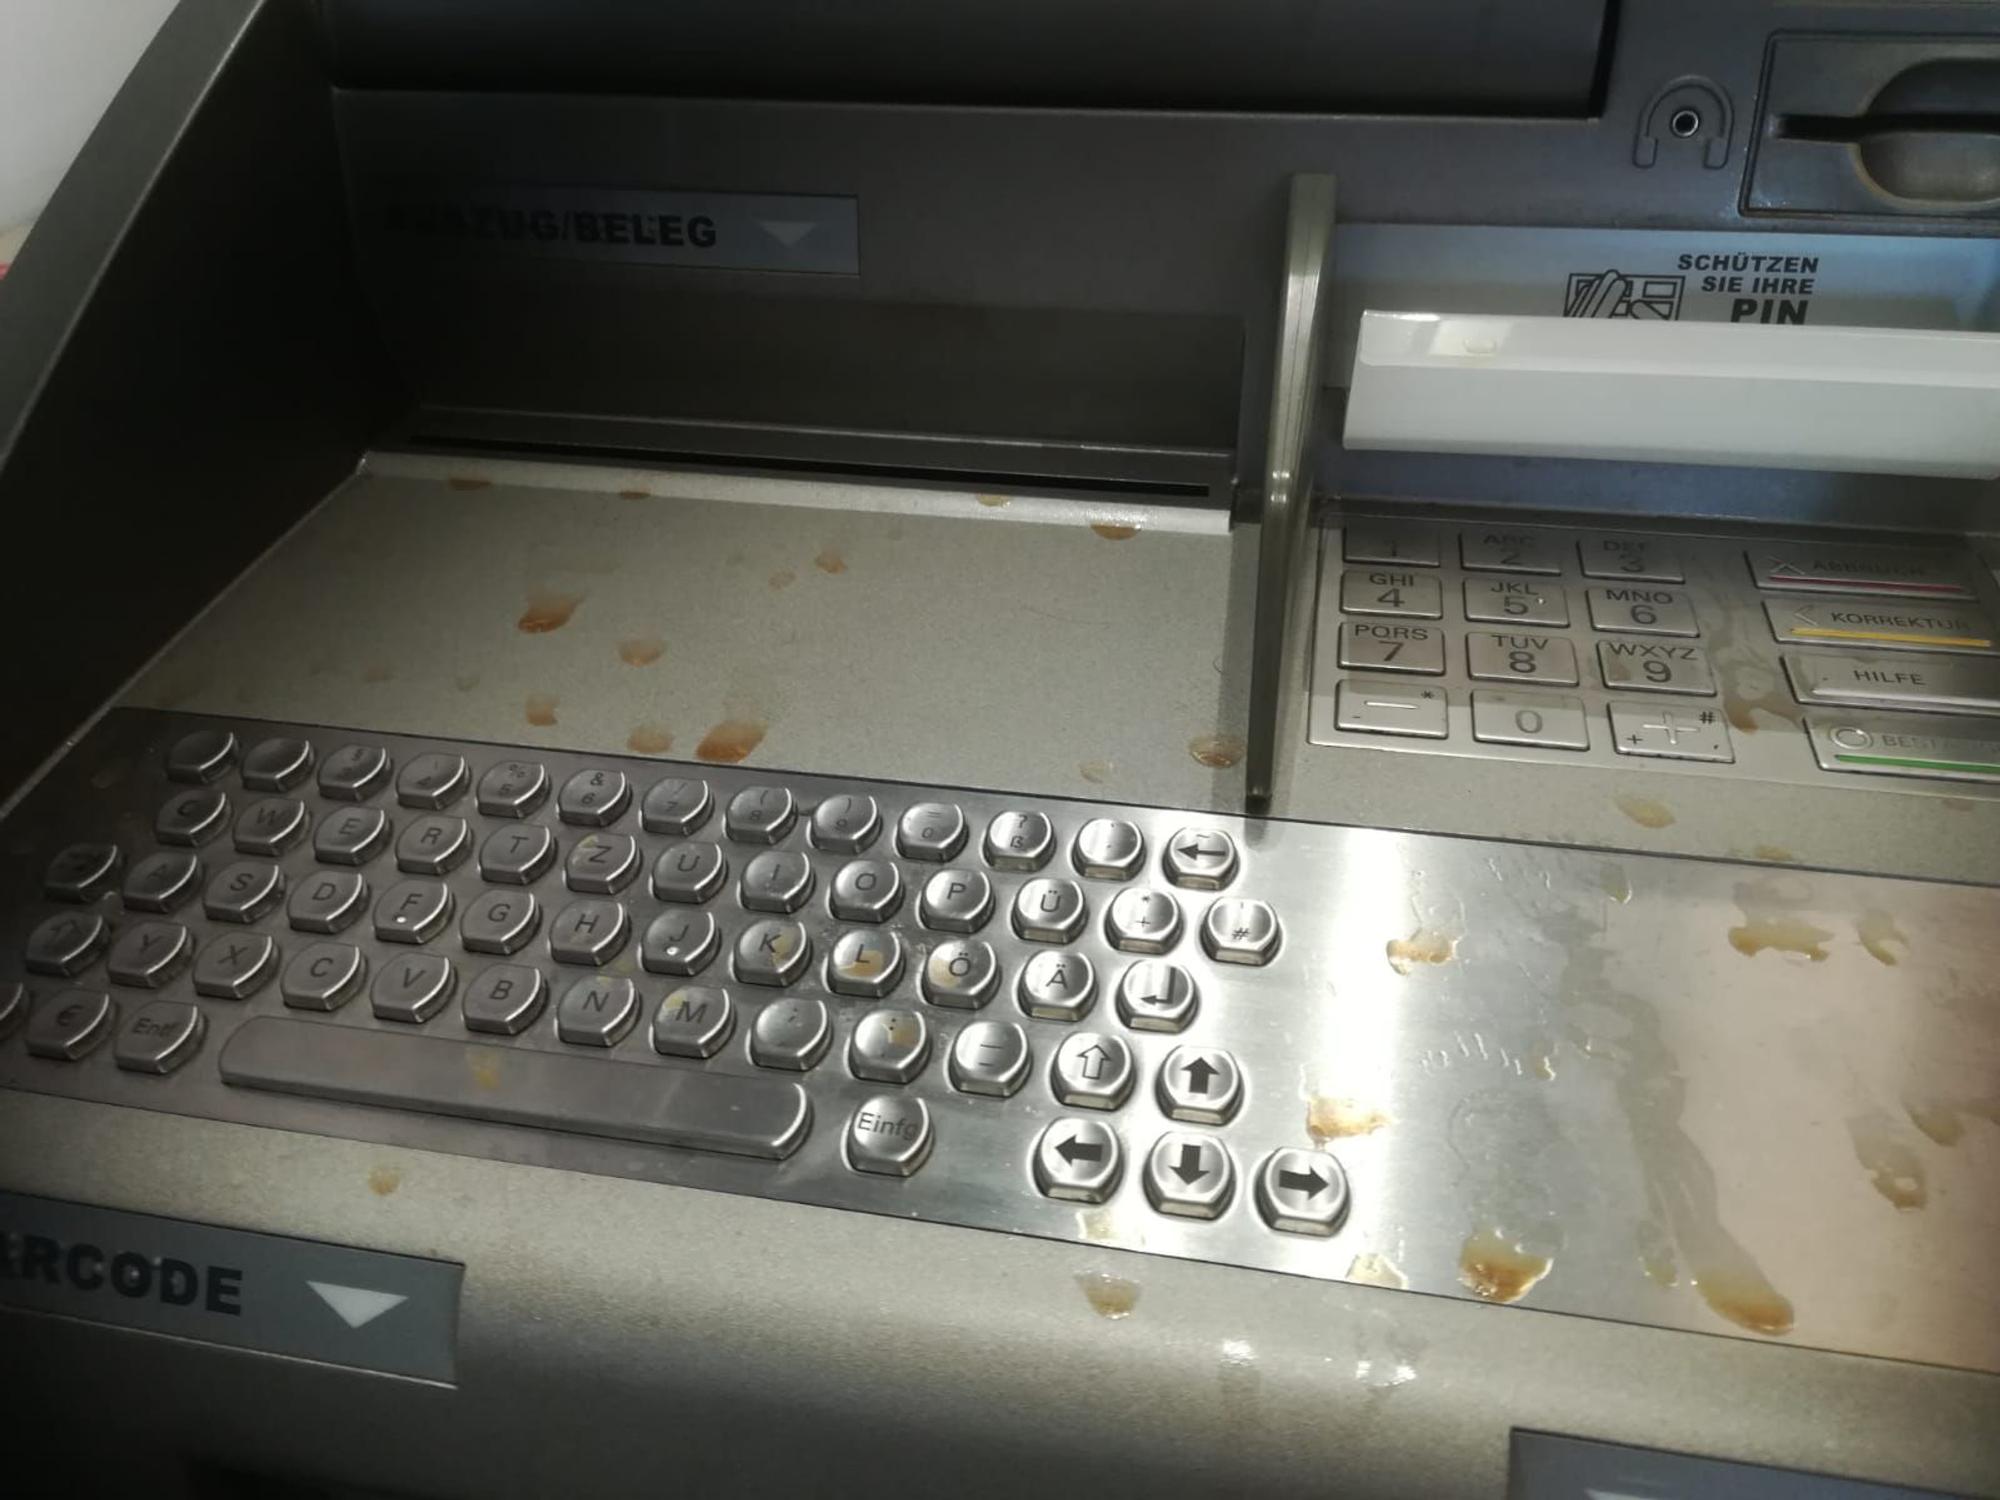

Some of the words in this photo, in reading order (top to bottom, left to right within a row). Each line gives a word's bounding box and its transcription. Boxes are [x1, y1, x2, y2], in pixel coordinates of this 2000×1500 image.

[1678, 252, 1819, 274] SCHÜTZEN
[1701, 276, 1742, 293] SIE
[1752, 277, 1815, 295] IHRE
[1730, 298, 1809, 325] PIN
[1620, 552, 1646, 573] 3
[1369, 572, 1415, 587] GHI
[1490, 581, 1539, 596] JKL
[1376, 588, 1405, 608] 4
[1503, 595, 1529, 616] 5
[1605, 589, 1673, 605] MNO
[1631, 604, 1657, 626] 6
[1354, 623, 1429, 642] PQRS
[1490, 633, 1550, 652] TUV
[1377, 641, 1405, 663] 7
[1508, 650, 1538, 674] 8
[1608, 641, 1700, 662] WXYZ
[1641, 660, 1673, 684] 9
[1853, 669, 1927, 686] HILFE
[1515, 709, 1543, 735] 0
[338, 817, 361, 836] E
[419, 826, 443, 846] R
[508, 835, 529, 854] T
[588, 845, 614, 864] Z
[677, 853, 701, 873] U
[229, 872, 255, 892] S
[311, 882, 337, 900] D
[854, 872, 877, 892] O
[946, 881, 967, 901] P
[400, 892, 424, 911] F
[1039, 889, 1062, 914] Ü
[487, 902, 512, 923] G
[573, 913, 600, 934] H
[669, 924, 690, 943] J
[758, 933, 783, 954] K
[854, 943, 871, 965] L
[218, 944, 249, 966] X
[948, 951, 971, 978] Ö
[309, 956, 335, 978] C
[1045, 963, 1069, 990] Ä
[401, 966, 428, 990] V
[488, 979, 514, 1001] B
[581, 990, 610, 1013] N
[674, 1000, 708, 1024] M
[856, 1110, 919, 1142] Einfg
